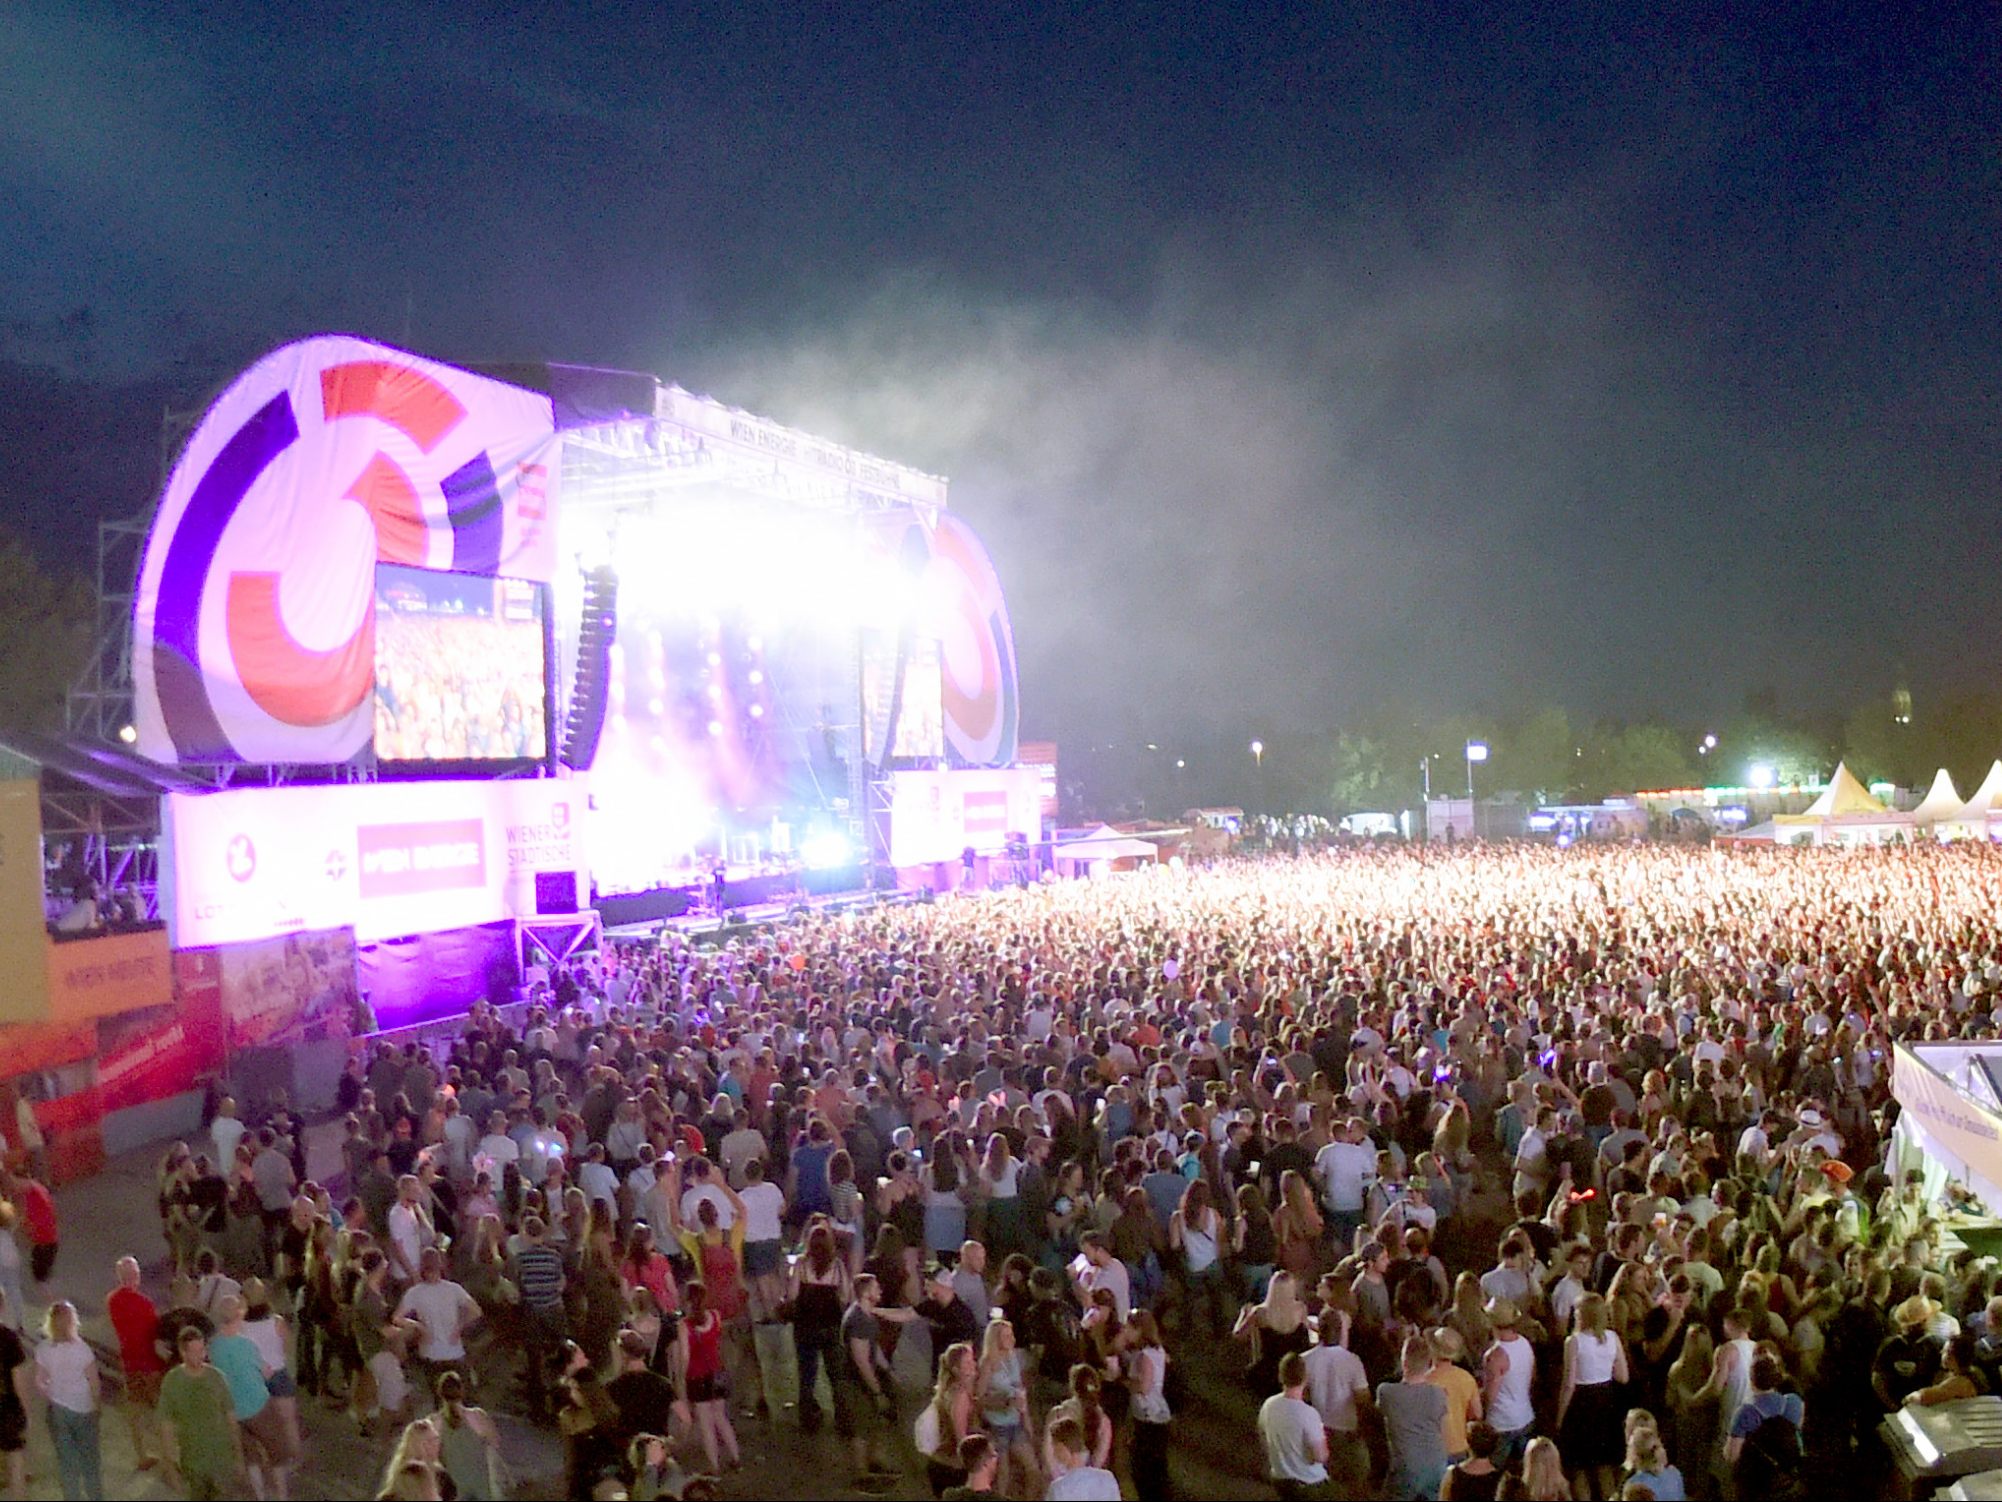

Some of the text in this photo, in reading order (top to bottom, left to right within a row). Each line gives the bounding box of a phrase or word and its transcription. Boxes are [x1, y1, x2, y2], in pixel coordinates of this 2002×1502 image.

[731, 419, 755, 444] WIEN
[758, 427, 797, 456] ENERGIE
[506, 824, 551, 844] WIENER
